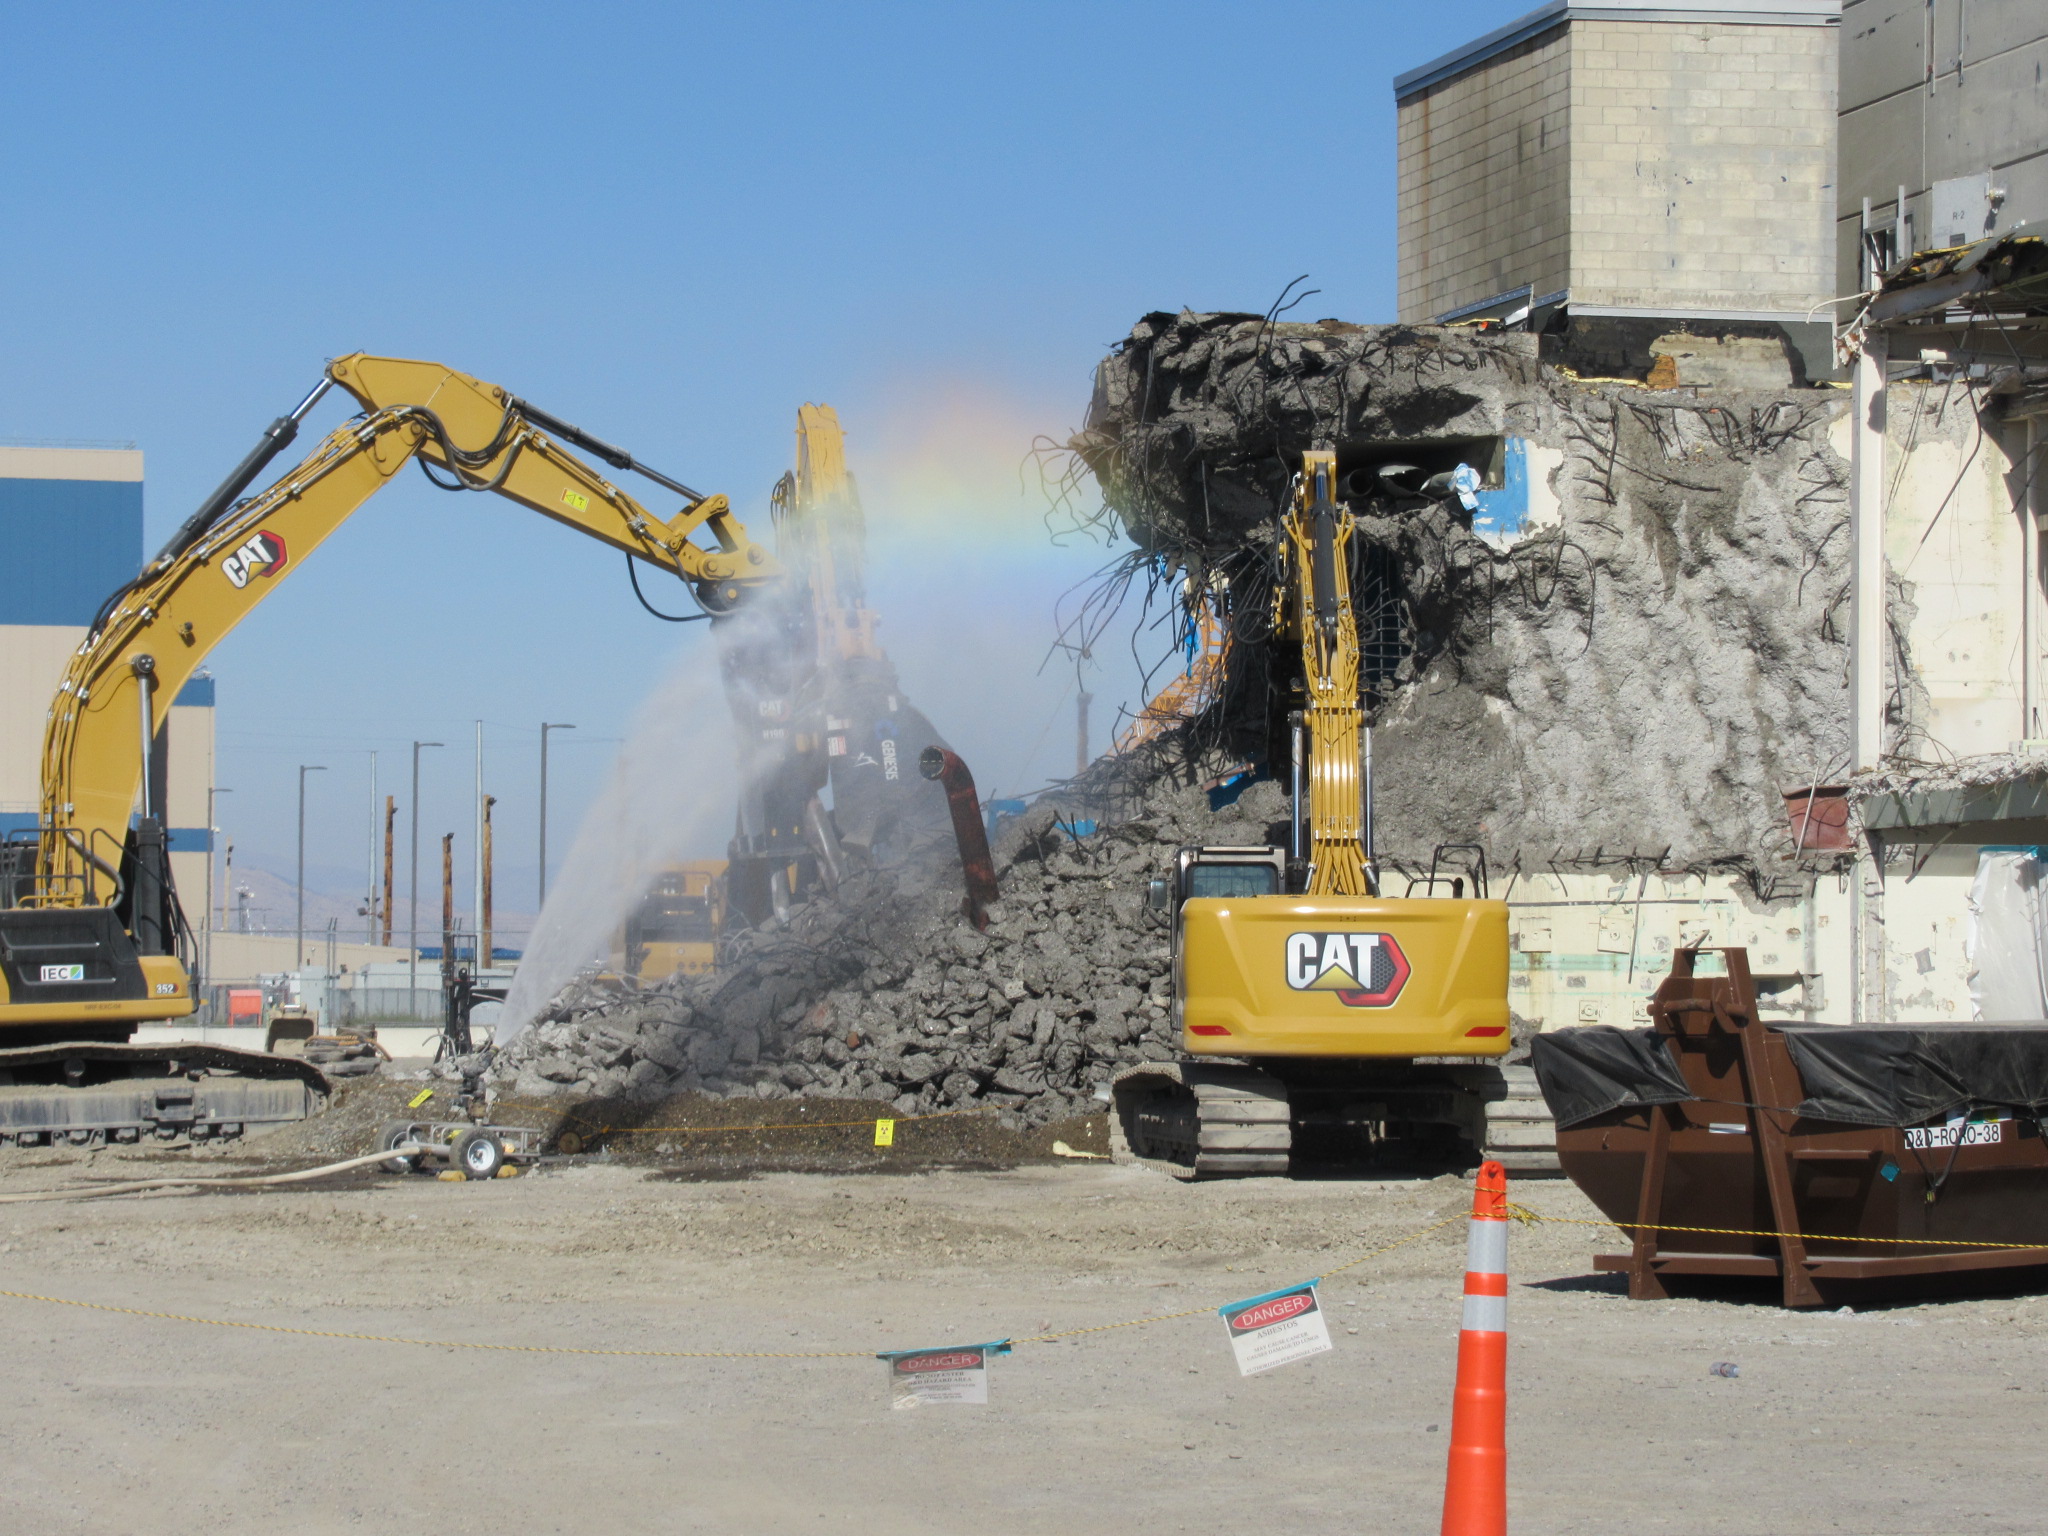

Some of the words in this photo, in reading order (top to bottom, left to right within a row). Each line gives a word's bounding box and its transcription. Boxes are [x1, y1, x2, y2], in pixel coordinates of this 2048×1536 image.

[222, 533, 274, 588] CAT
[759, 699, 784, 717] CAT
[881, 739, 899, 780] GENESIS
[1287, 933, 1379, 989] CAT
[43, 967, 68, 980] IEC
[156, 983, 174, 994] 352
[1242, 1297, 1305, 1326] DANGER
[1256, 1320, 1298, 1339] ASBESTOS
[1254, 1344, 1267, 1353] MAY
[1267, 1338, 1285, 1349] CAUSE
[1285, 1332, 1308, 1344] CANCER
[1268, 1344, 1294, 1355] DAMAGE
[908, 1354, 972, 1369] DANGER
[924, 1377, 952, 1385] HAZARD
